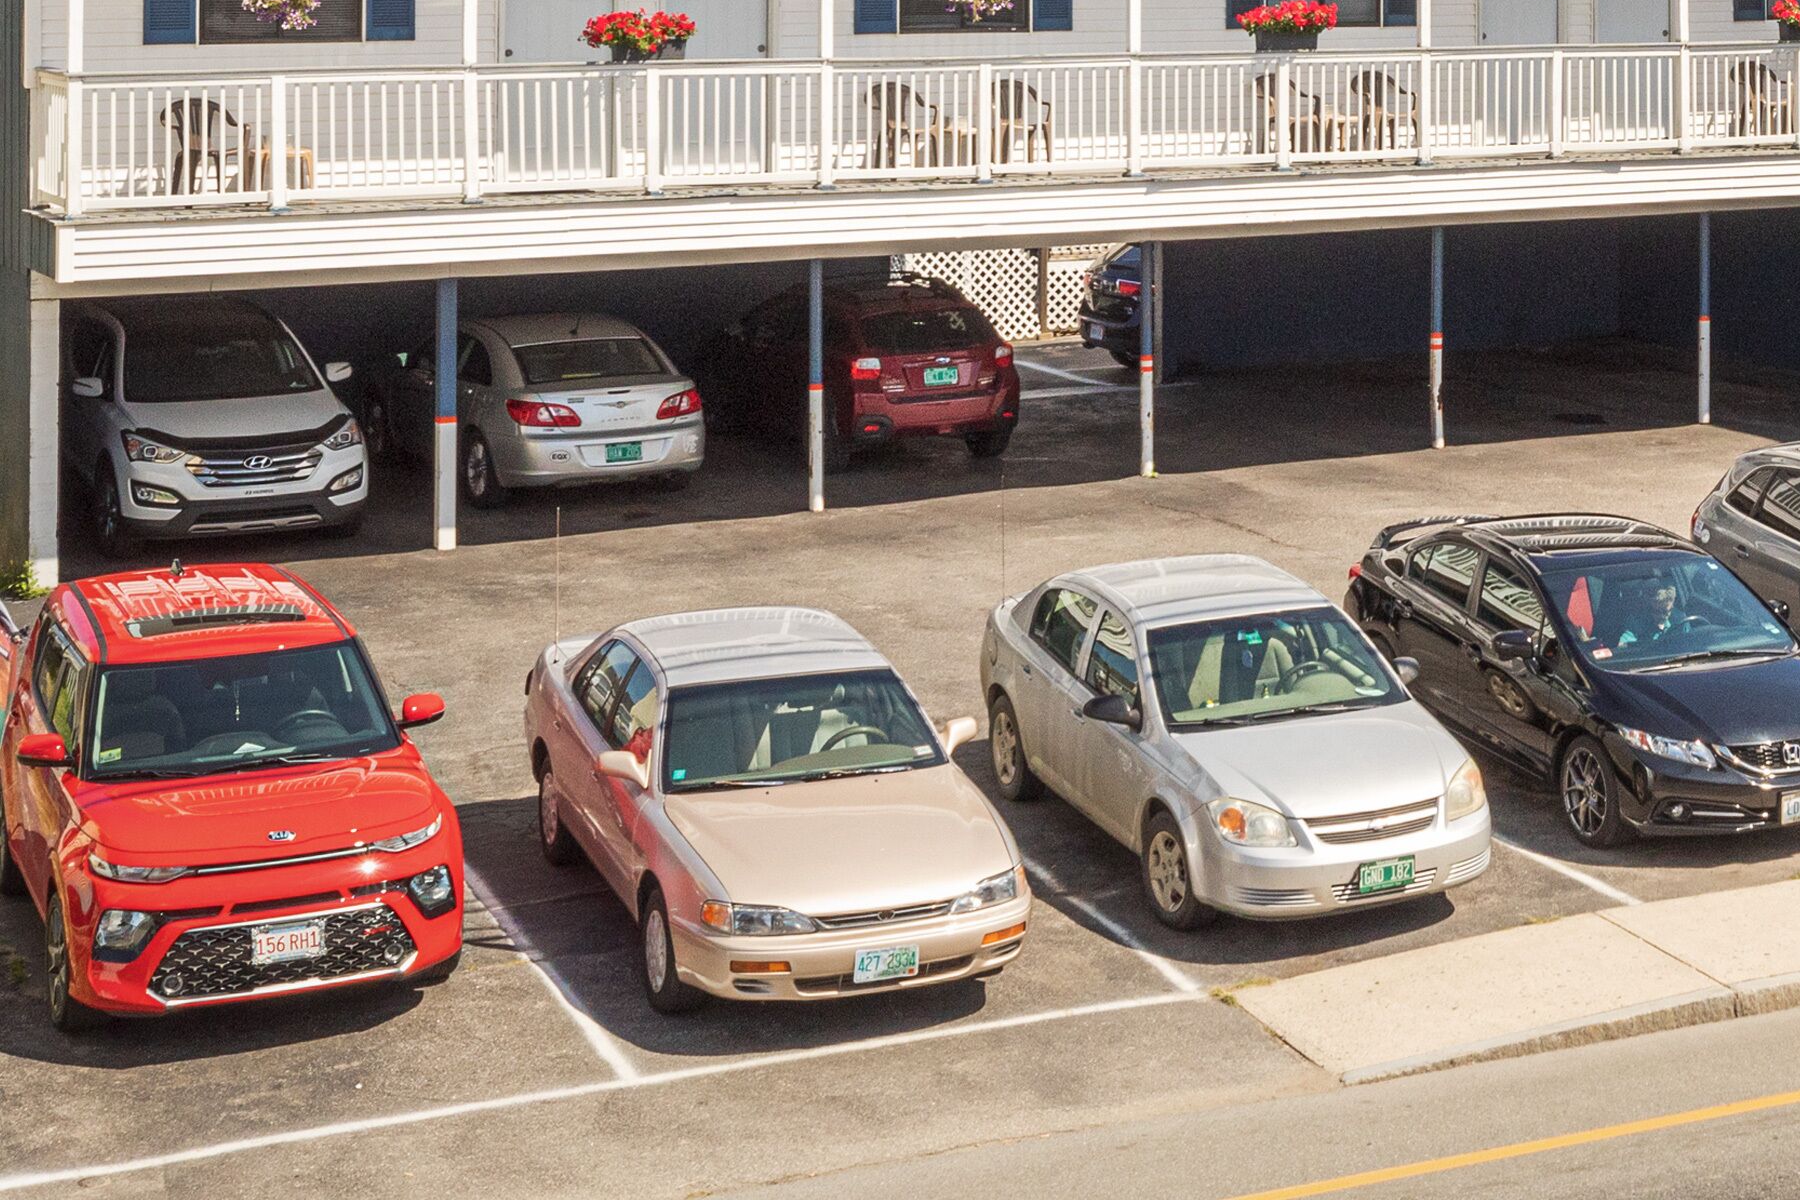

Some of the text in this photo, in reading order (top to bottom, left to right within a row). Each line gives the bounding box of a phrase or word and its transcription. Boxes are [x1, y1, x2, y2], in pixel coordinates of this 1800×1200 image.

[1390, 862, 1411, 882] 182
[257, 930, 320, 956] 156 RH1
[858, 954, 880, 972] 427
[887, 951, 916, 970] 2934
